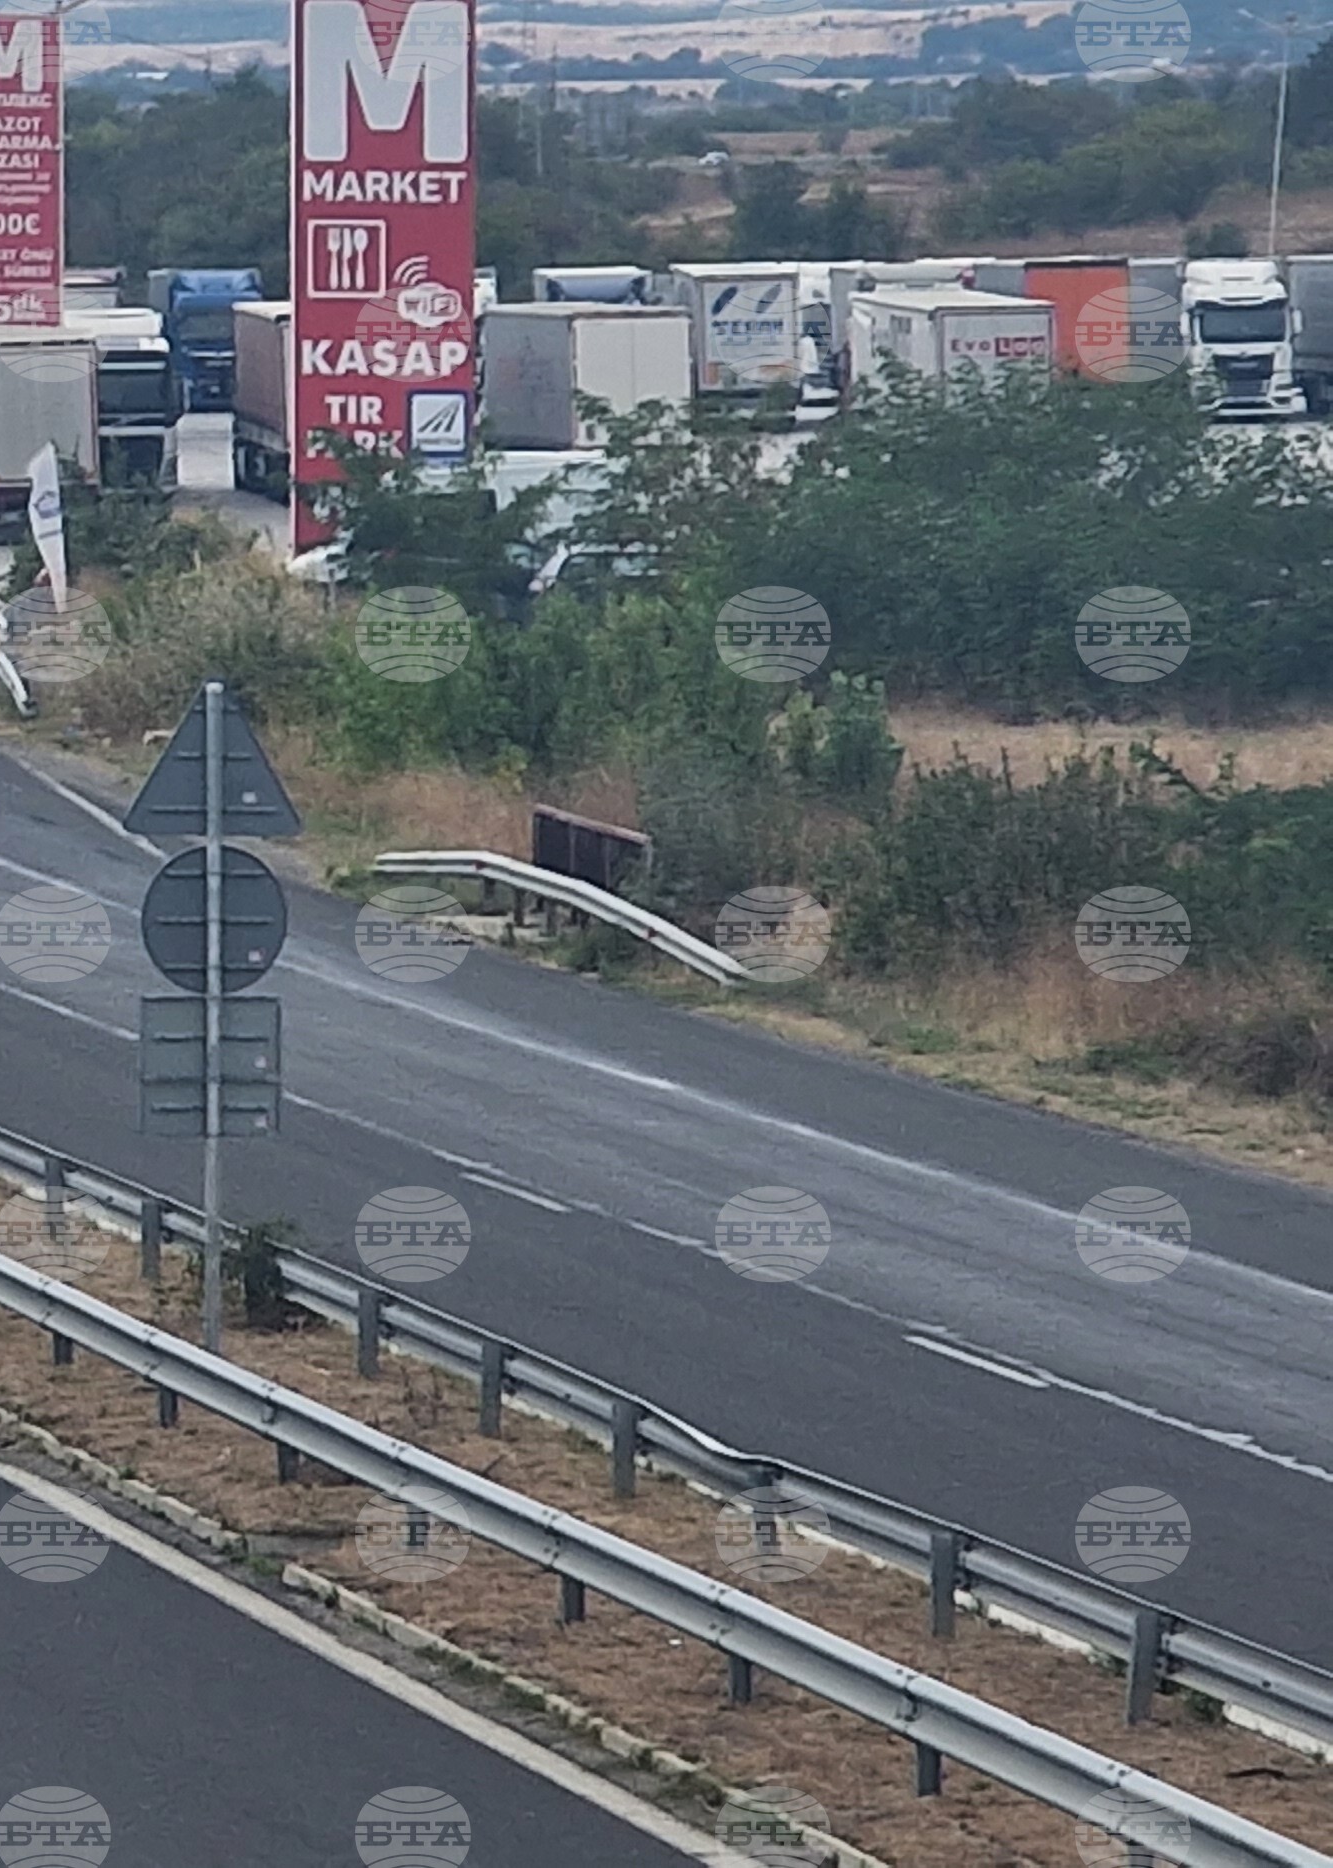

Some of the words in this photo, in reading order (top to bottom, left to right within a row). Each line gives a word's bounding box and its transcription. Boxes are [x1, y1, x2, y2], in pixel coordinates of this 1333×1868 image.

[304, 1, 468, 163] M
[302, 170, 467, 203] MARKET
[301, 340, 468, 376] KASAP
[324, 395, 383, 424] TIR
